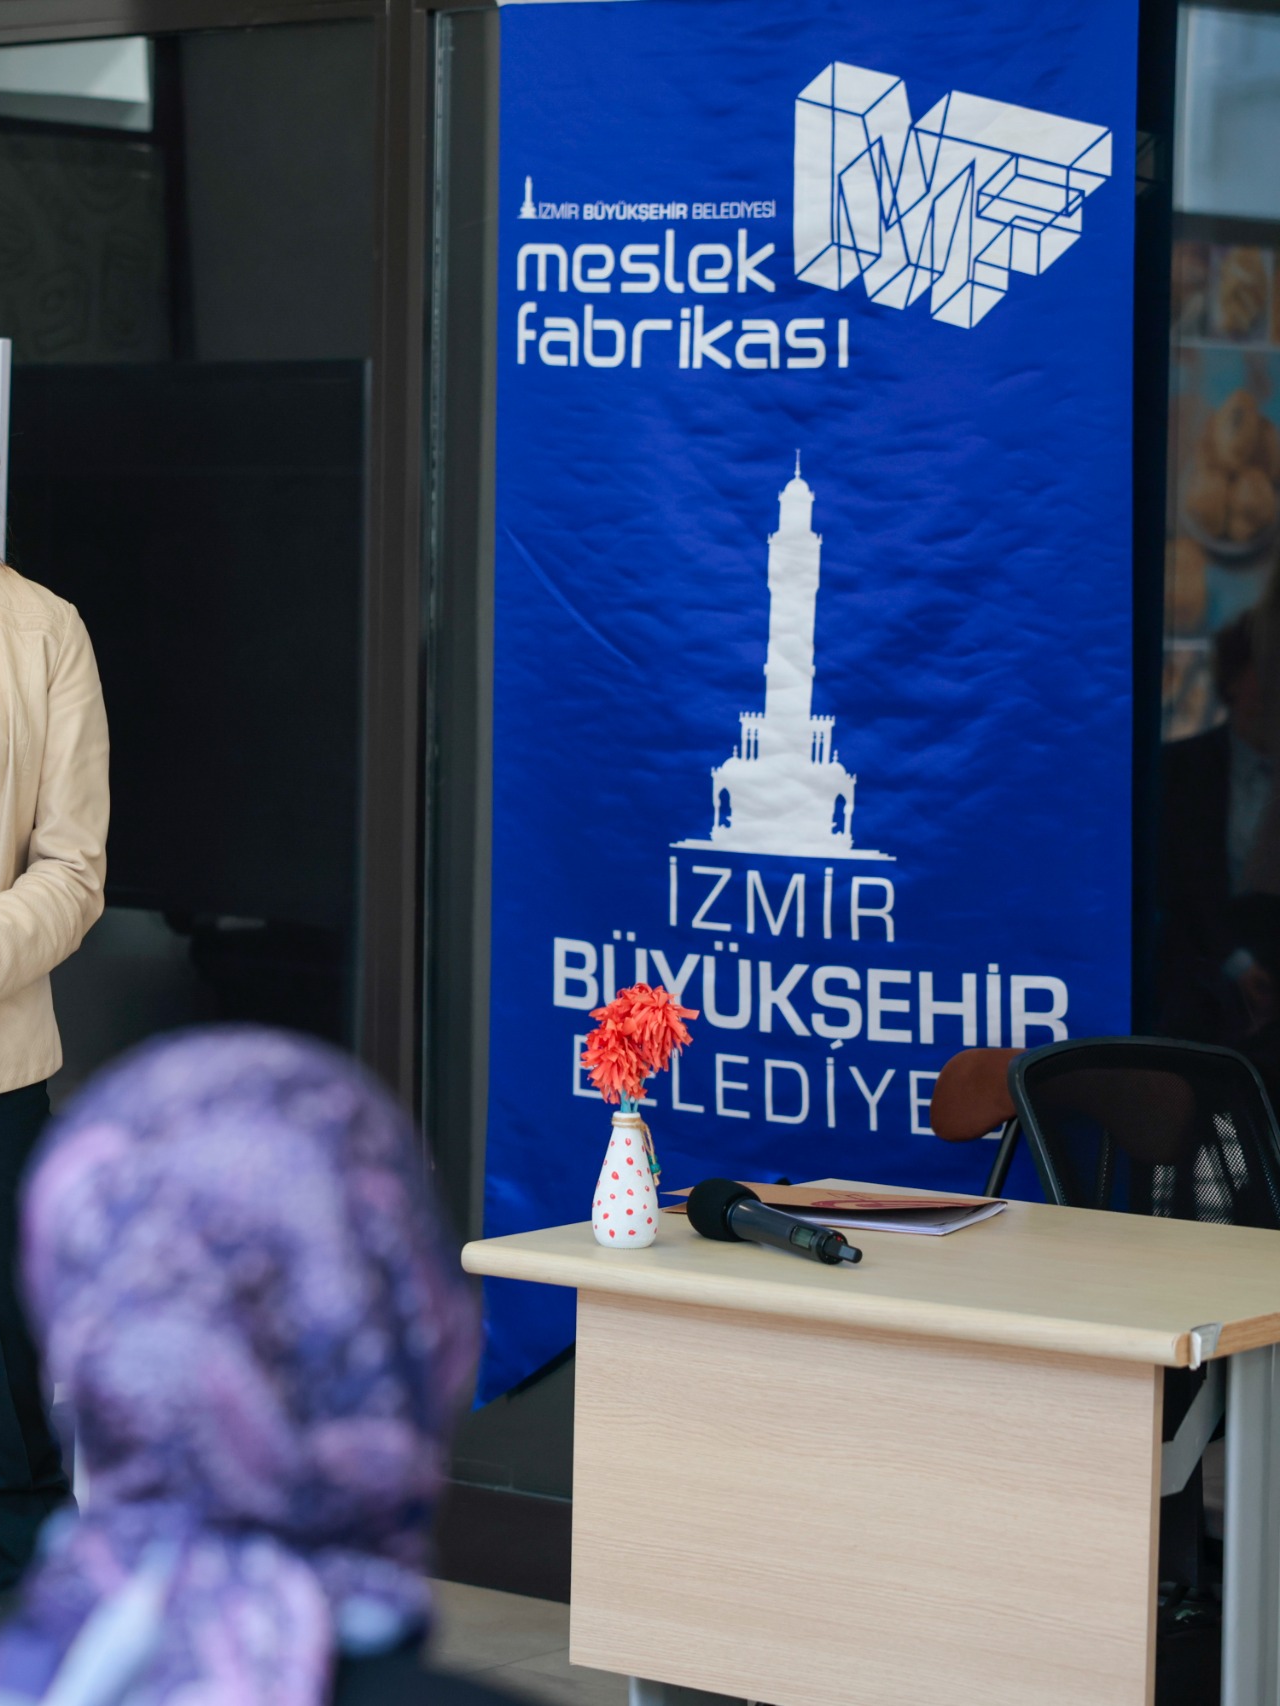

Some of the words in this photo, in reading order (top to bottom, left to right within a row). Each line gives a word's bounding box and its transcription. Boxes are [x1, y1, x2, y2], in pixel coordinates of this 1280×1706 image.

[538, 201, 580, 220] İZMİR
[582, 200, 688, 222] BÜYÜKŞEHİR
[691, 199, 777, 220] BELEDİYESİ
[516, 228, 776, 293] meslek
[516, 302, 849, 369] fabrikası
[668, 856, 897, 942] İZMİR
[553, 930, 1069, 1050] BÜYÜKŞEHİR
